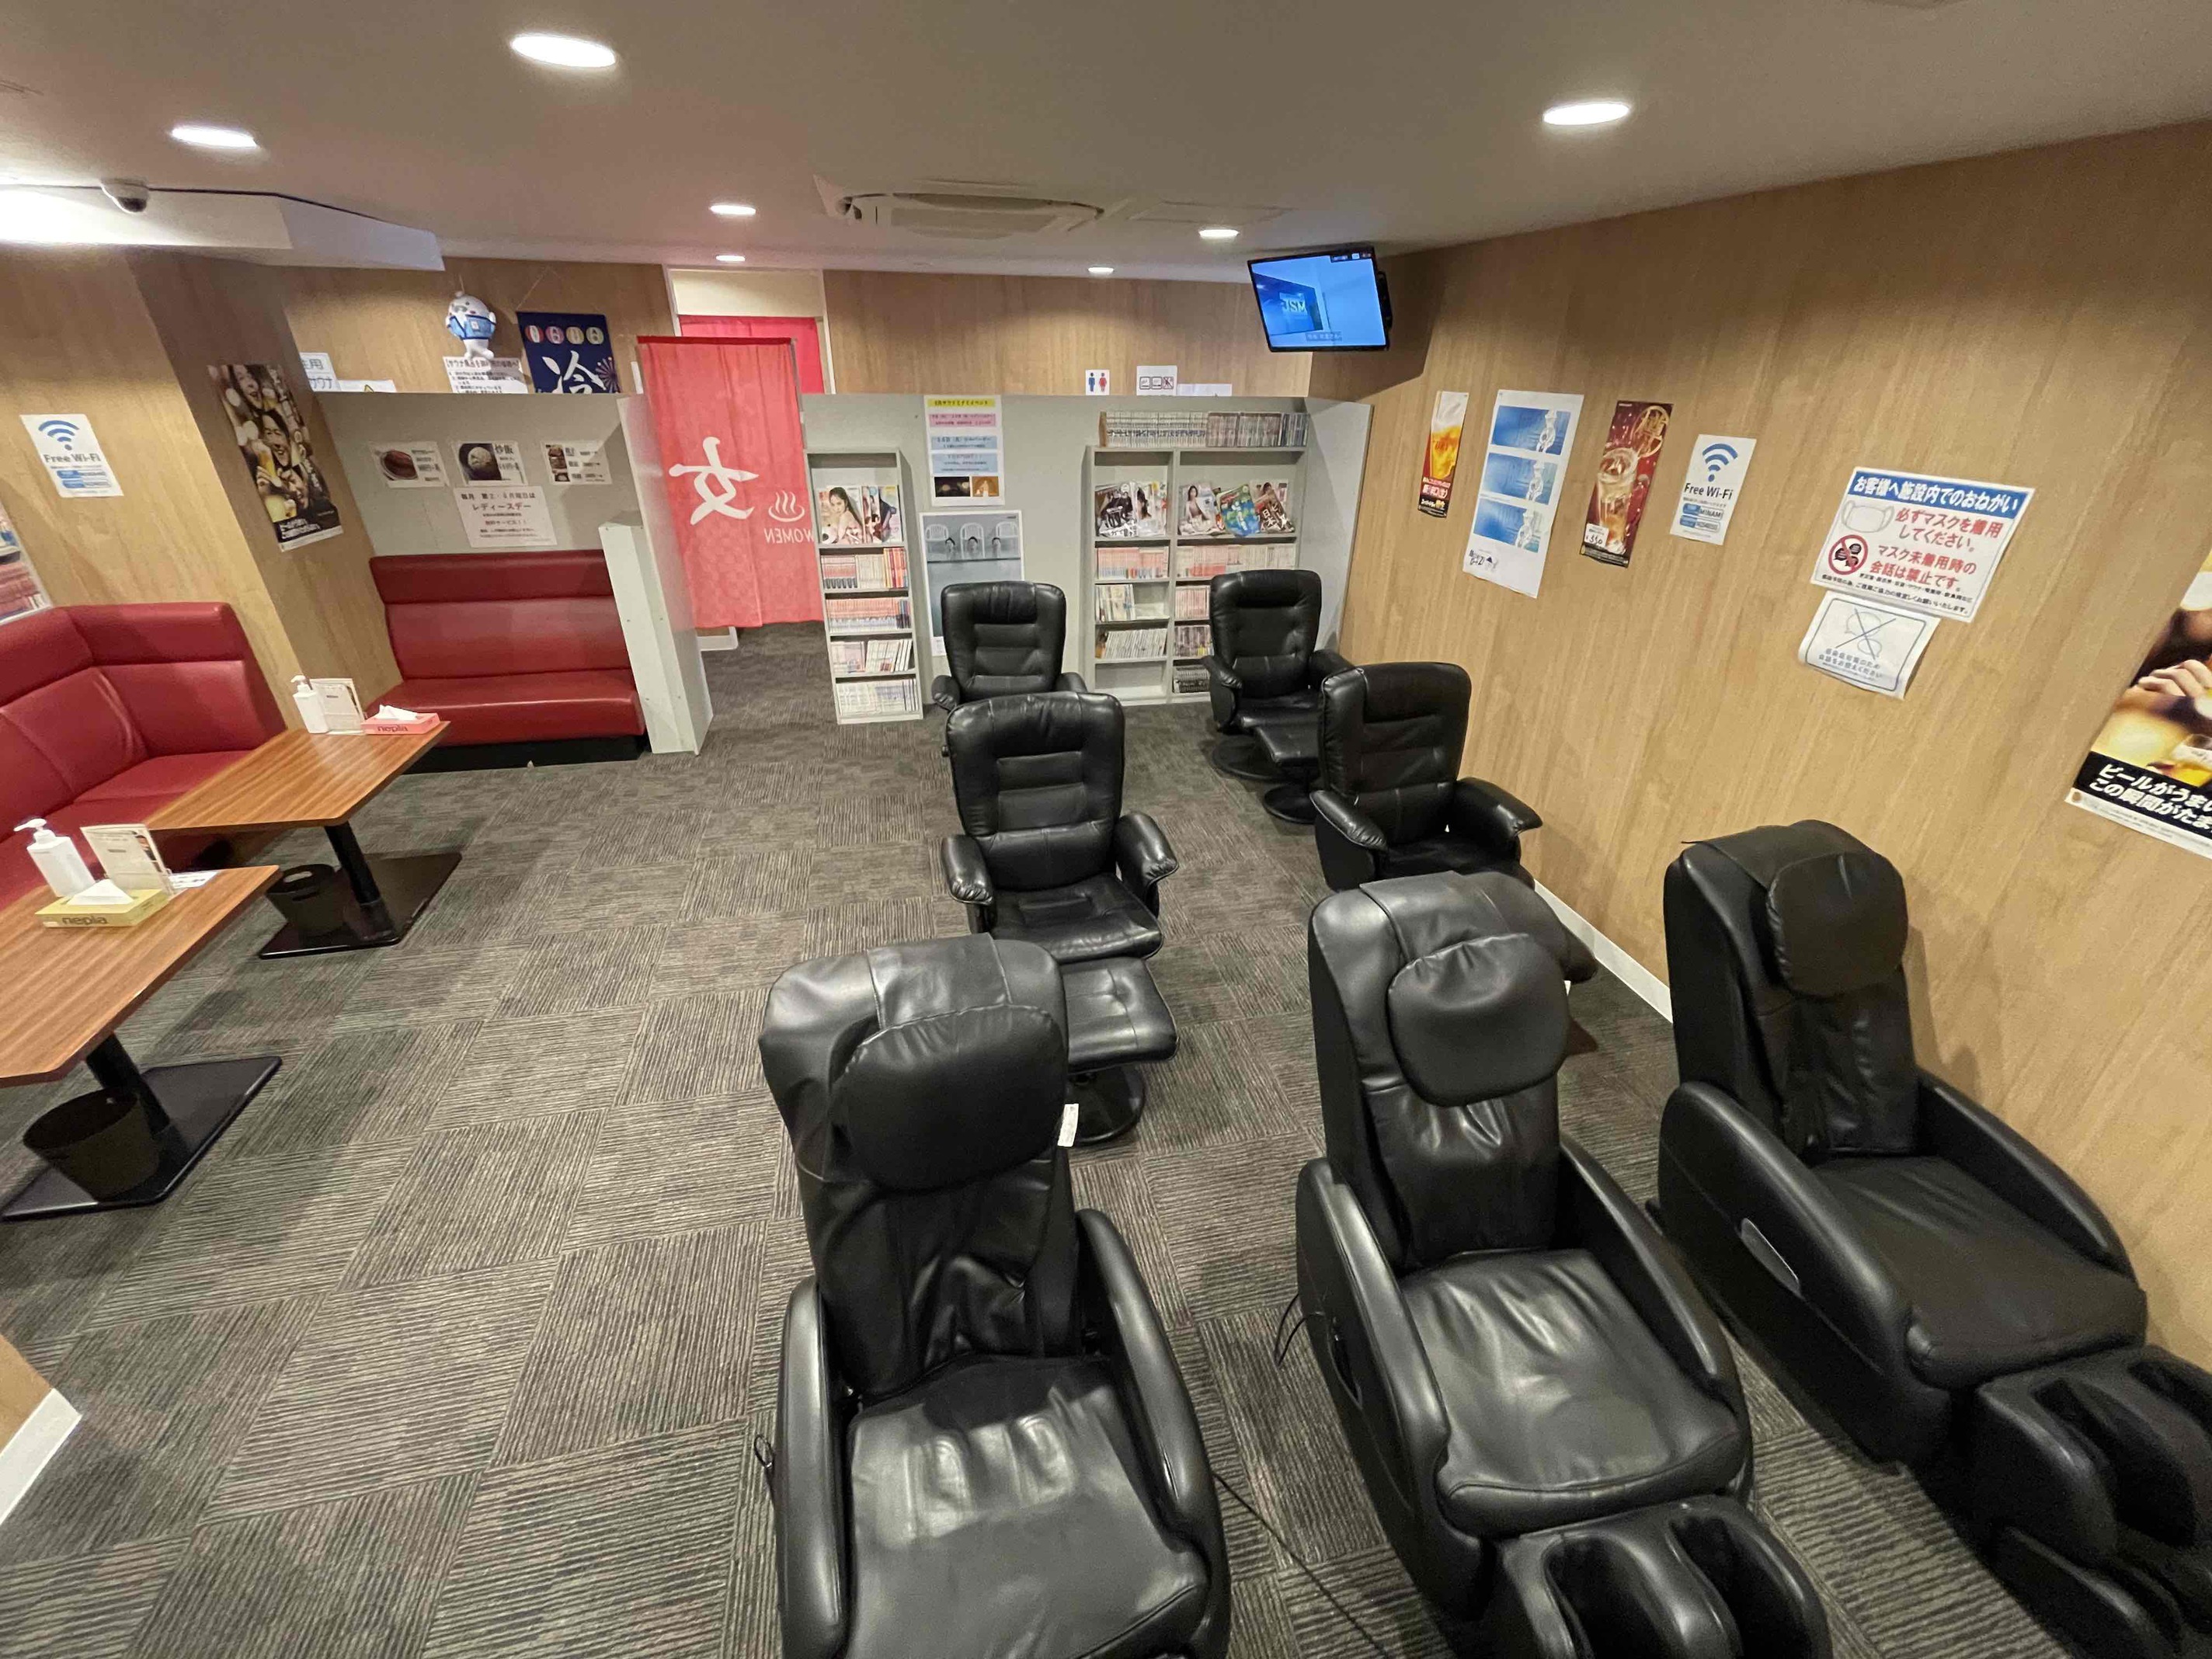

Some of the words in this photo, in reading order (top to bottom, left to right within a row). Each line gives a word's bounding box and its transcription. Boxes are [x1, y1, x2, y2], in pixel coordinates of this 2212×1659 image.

[71, 453, 101, 462] Wi-Fi
[1684, 482, 1704, 496] Free
[1706, 485, 1734, 500] Wi-Fi
[1854, 476, 2018, 513] お客様へ施設内でのおねがい
[1895, 507, 2004, 538] 必ずマスクを着用
[1899, 526, 1975, 552] してください。
[1878, 544, 1977, 575] マスク未着用時の
[1869, 560, 1961, 592] 会話は禁止です。
[2089, 777, 2212, 833] この瞬間がたま
